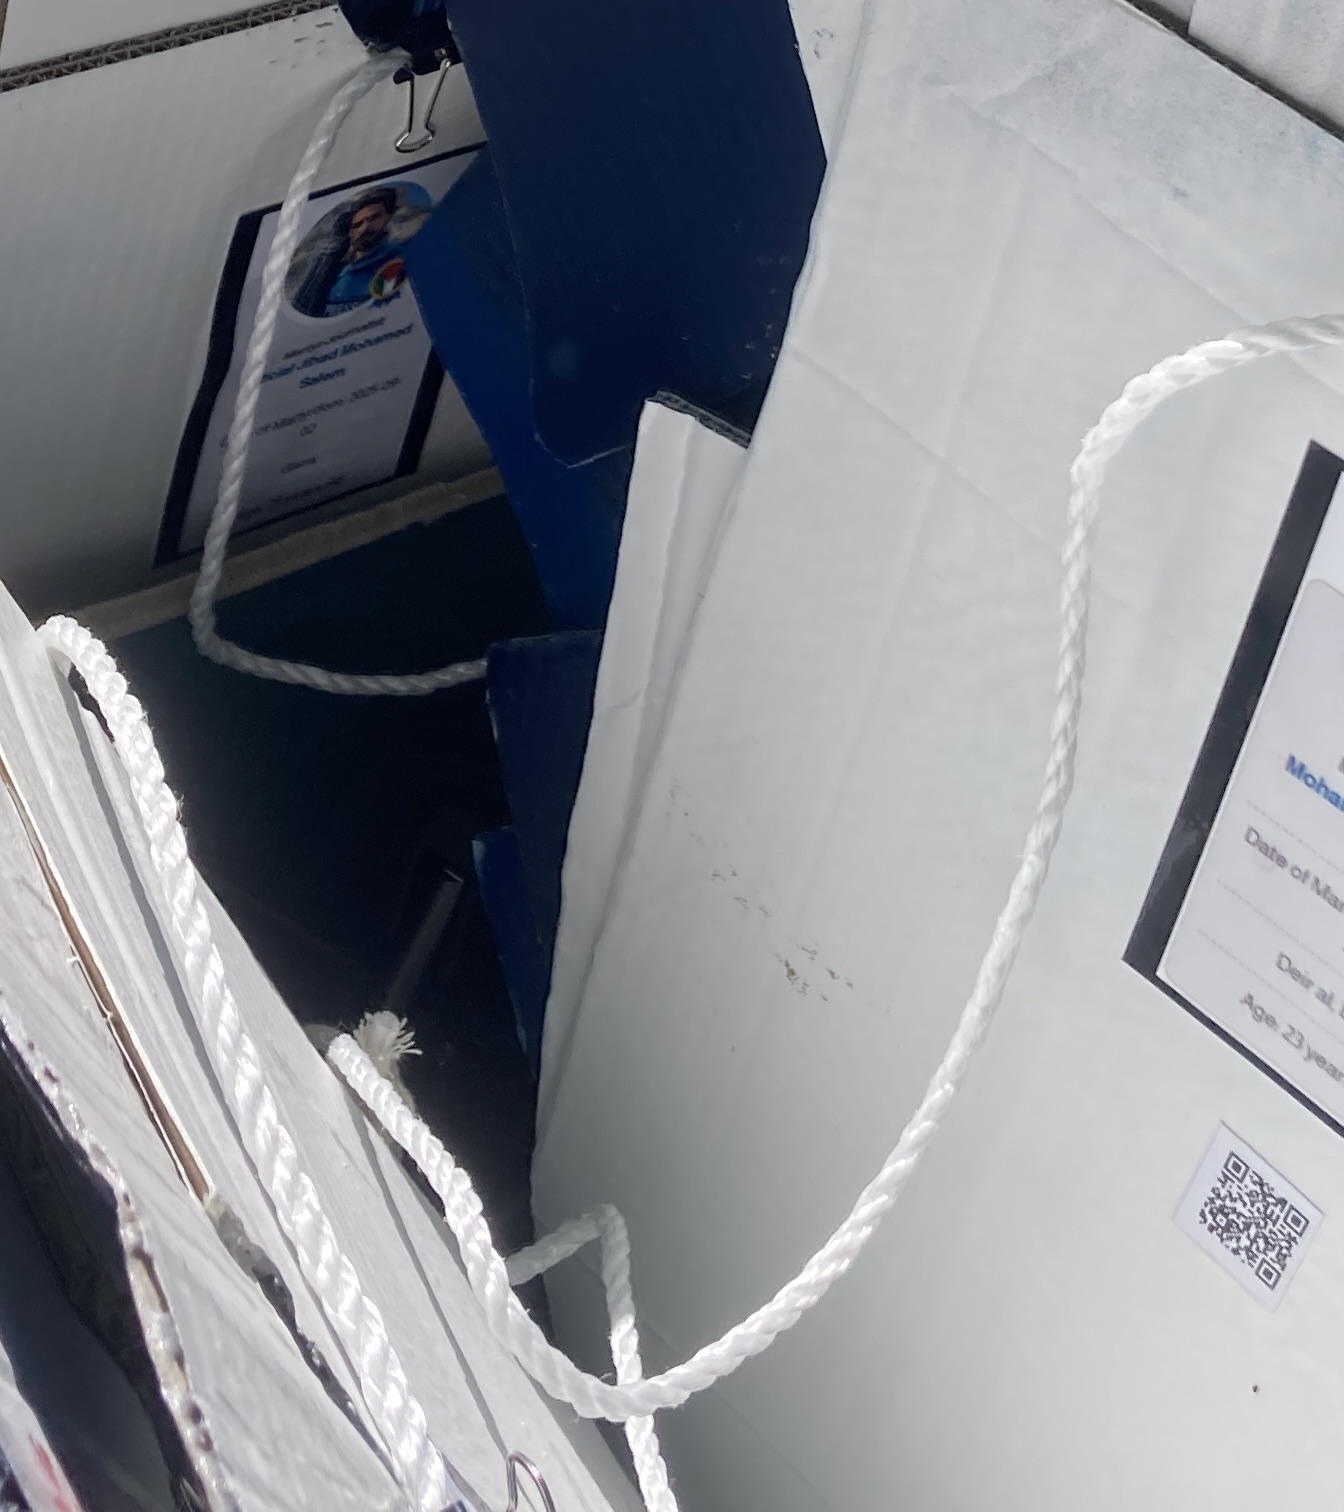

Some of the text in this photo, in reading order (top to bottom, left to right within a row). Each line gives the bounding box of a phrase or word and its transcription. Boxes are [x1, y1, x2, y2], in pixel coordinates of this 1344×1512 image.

[1243, 825, 1288, 869] Date
[1289, 863, 1312, 885] of
[1275, 950, 1316, 991] Deir
[1281, 1024, 1306, 1050] 23
